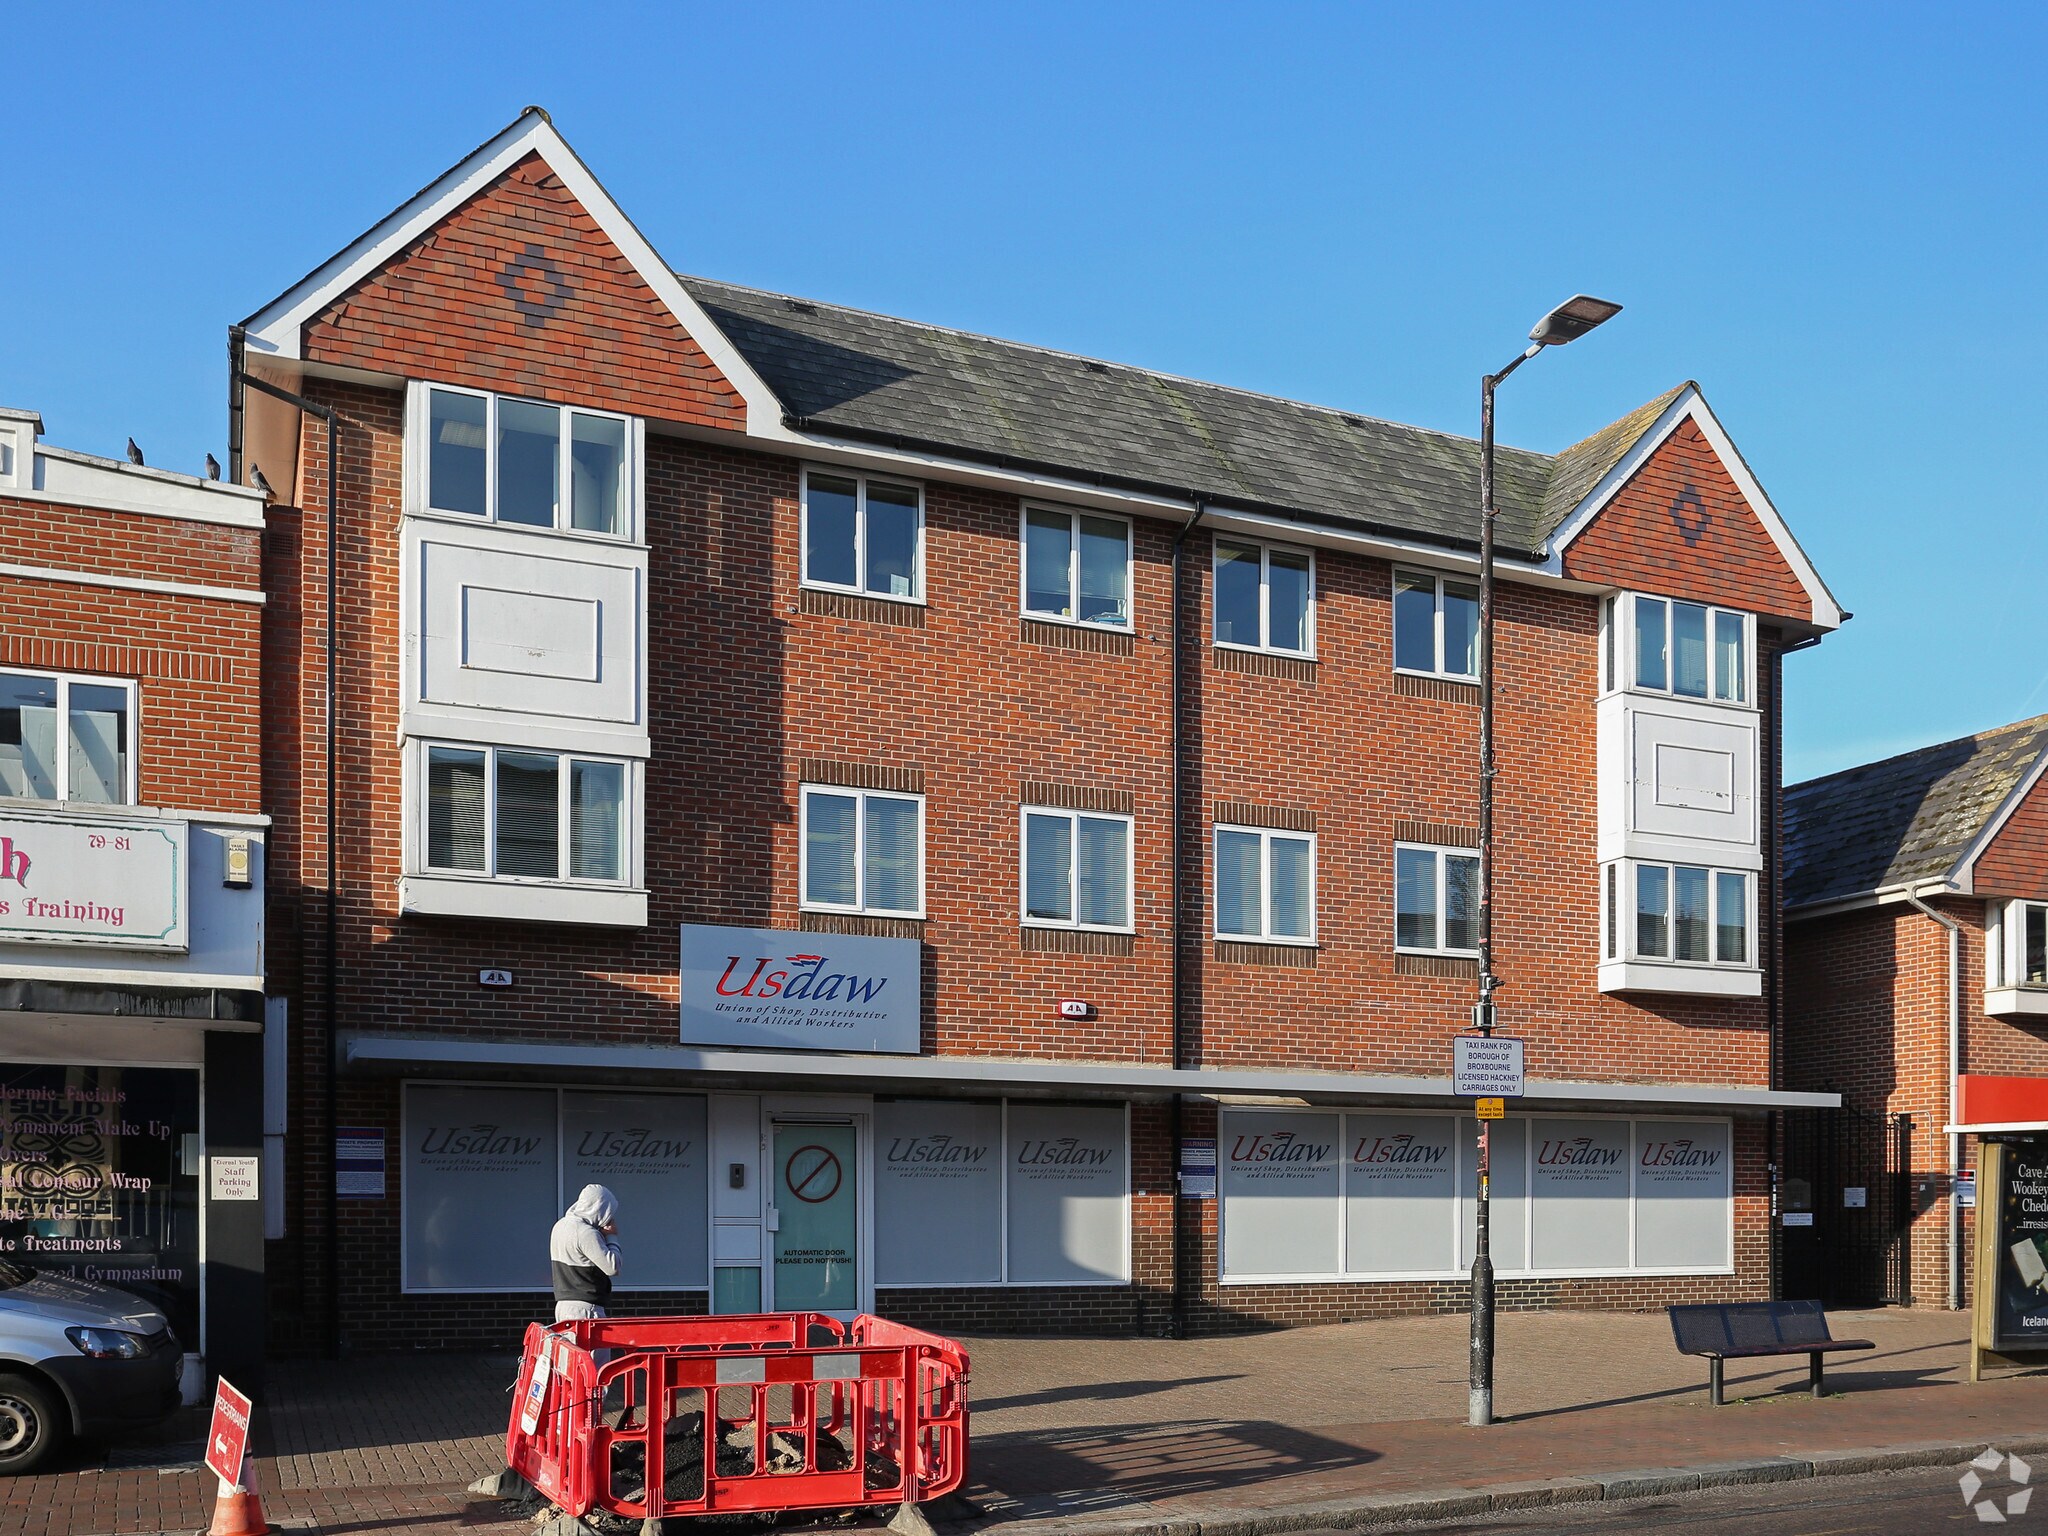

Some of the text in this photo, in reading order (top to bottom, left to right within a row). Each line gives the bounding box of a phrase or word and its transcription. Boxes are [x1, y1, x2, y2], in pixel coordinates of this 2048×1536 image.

[88, 834, 131, 851] 79-81
[22, 897, 124, 926] Training
[715, 954, 887, 1004] Usdaw
[715, 1003, 888, 1020] Union of Shop, Distributive
[736, 1016, 855, 1029] and Allied Workers
[1480, 1042, 1498, 1050] RANK
[1468, 1052, 1500, 1060] BOROUGH
[1467, 1063, 1511, 1071] BROXBOURNE
[1458, 1073, 1489, 1081] LICENSED
[65, 1085, 127, 1102] Facials
[1500, 1084, 1516, 1092] ONLY
[94, 1120, 140, 1136] Make
[149, 1121, 171, 1140] Up
[420, 1124, 541, 1155] Usdaw
[577, 1128, 691, 1158] Usdaw
[1231, 1132, 1330, 1162] Usdaw
[1354, 1134, 1447, 1163] Usdaw
[887, 1135, 988, 1163] Usdaw
[1018, 1138, 1112, 1165] Usdaw
[1538, 1138, 1622, 1166] Usdaw
[1641, 1140, 1721, 1167] Usdaw
[2018, 1163, 2043, 1178] Cave
[32, 1171, 101, 1190] Contour
[110, 1172, 151, 1192] Wrap
[219, 1178, 251, 1187] Parking
[226, 1188, 244, 1197] Only
[2022, 1198, 2048, 1212] Ched
[23, 1234, 122, 1253] Treatments
[85, 1264, 182, 1282] Gymnasium
[216, 1395, 247, 1431] PEDESTRIANS
